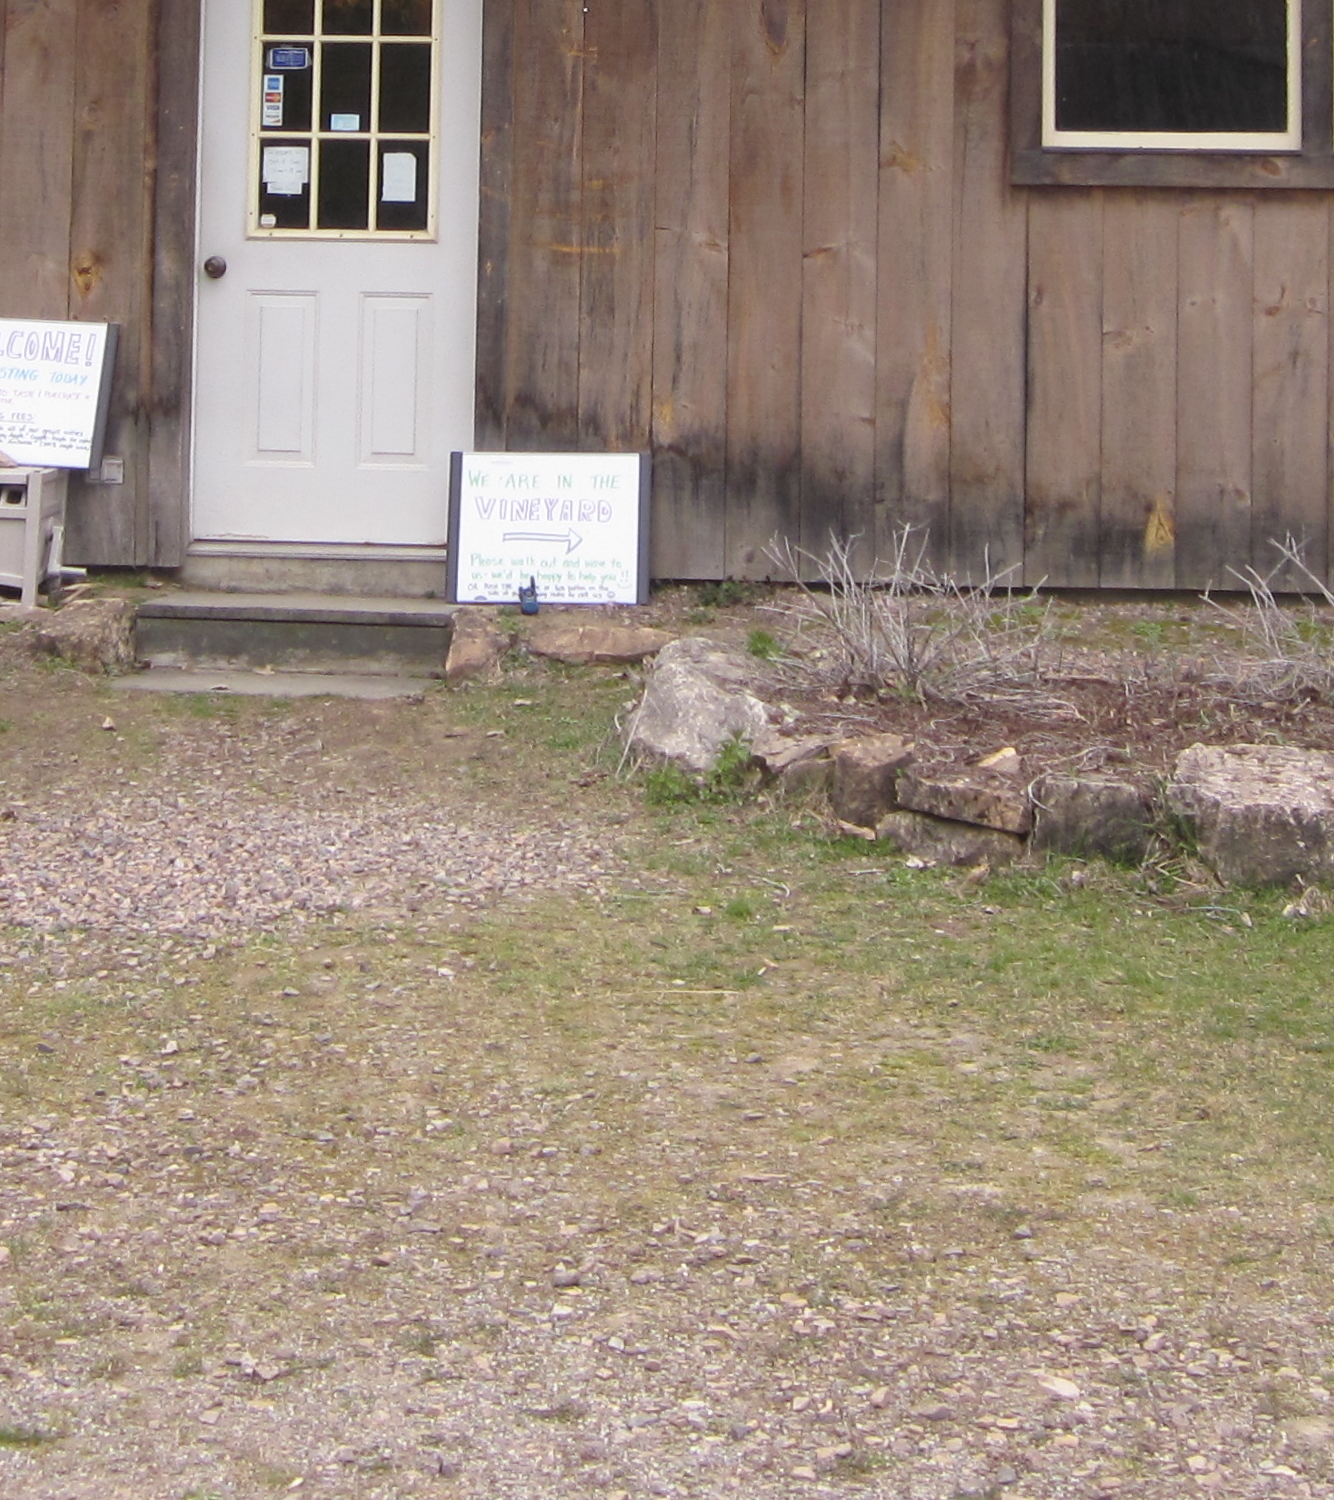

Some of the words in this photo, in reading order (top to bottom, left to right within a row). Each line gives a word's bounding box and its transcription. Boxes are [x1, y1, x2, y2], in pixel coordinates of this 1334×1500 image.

[50, 371, 88, 386] TODAY
[468, 470, 489, 488] WE
[505, 473, 539, 489] ARE
[557, 474, 572, 489] IN
[590, 474, 620, 489] THE
[474, 496, 613, 523] VINEYARD
